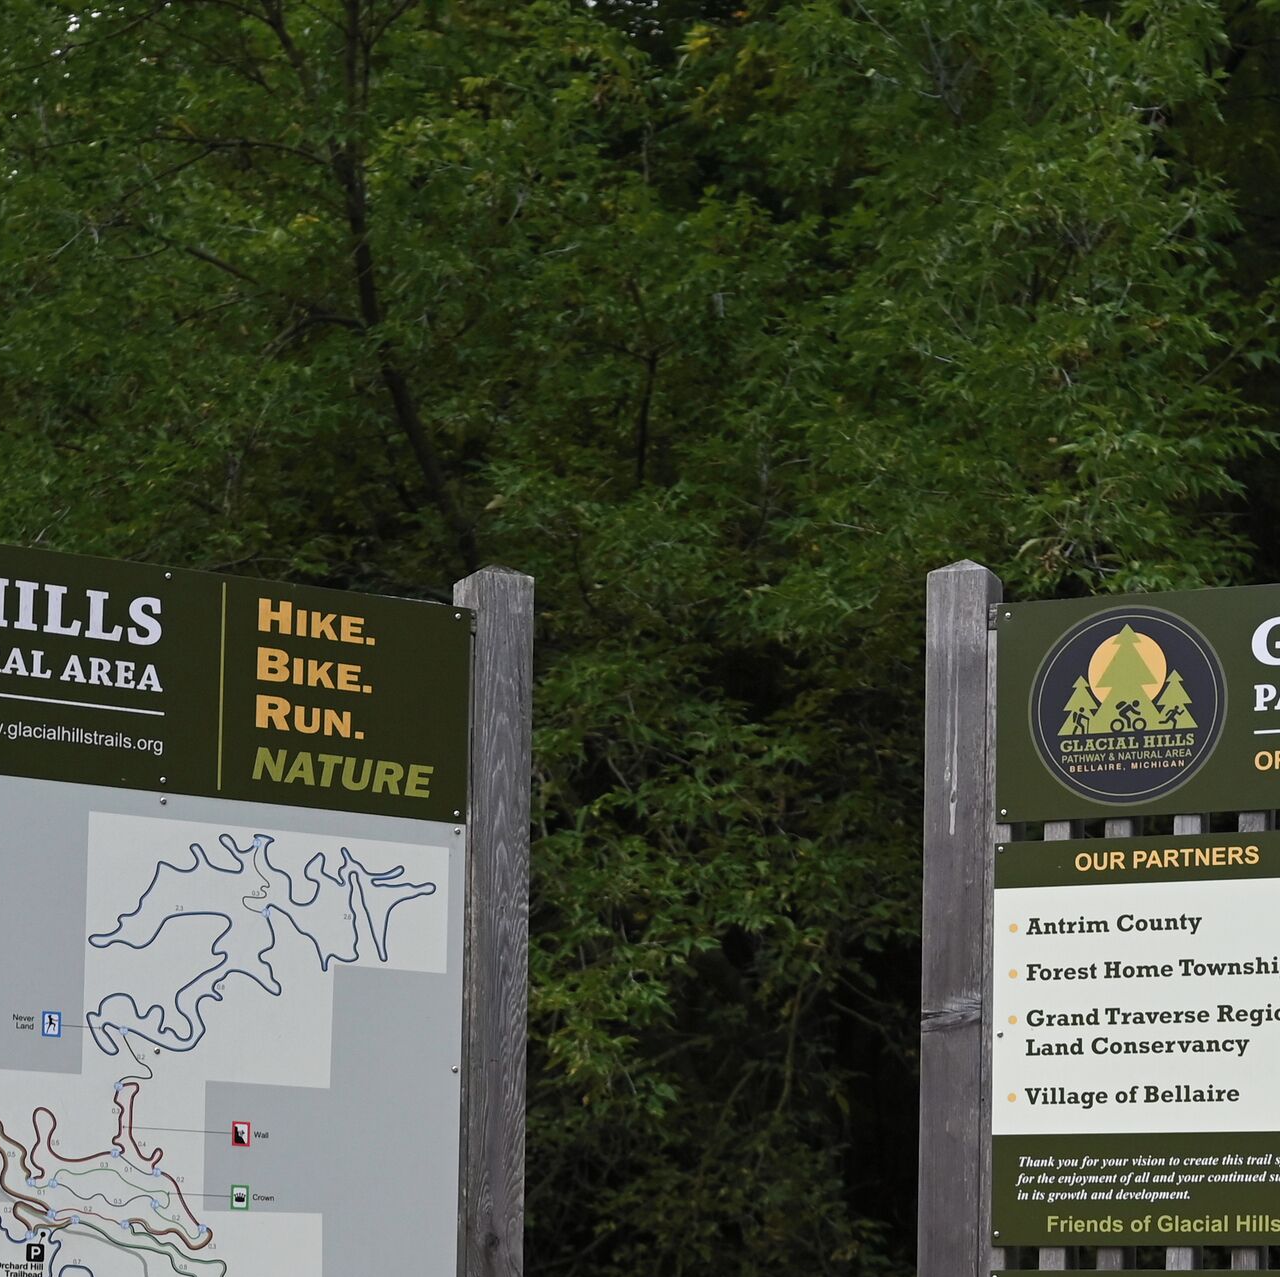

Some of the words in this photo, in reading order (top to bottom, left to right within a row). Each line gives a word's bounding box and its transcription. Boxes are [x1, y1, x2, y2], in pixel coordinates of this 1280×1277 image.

[60, 655, 163, 692] AREA
[252, 746, 434, 798] NATURE
[1075, 852, 1125, 871] OUR
[1133, 846, 1259, 869] PARTNERS
[1026, 916, 1110, 935] Antrim
[1117, 913, 1202, 935] County
[1026, 963, 1097, 981] Forest
[1104, 961, 1173, 979] Home
[1026, 1008, 1100, 1027] Grand
[1105, 1007, 1210, 1025] Traverse
[1025, 1038, 1084, 1056] Land
[1091, 1037, 1250, 1057] Conservancy
[1024, 1087, 1108, 1109] Village
[1115, 1085, 1139, 1104] of
[1143, 1084, 1240, 1103] Bellaire
[1047, 1215, 1123, 1232] Friends
[1130, 1215, 1152, 1232] of
[1157, 1215, 1228, 1232] Glacial
[29, 1262, 45, 1272] Hill
